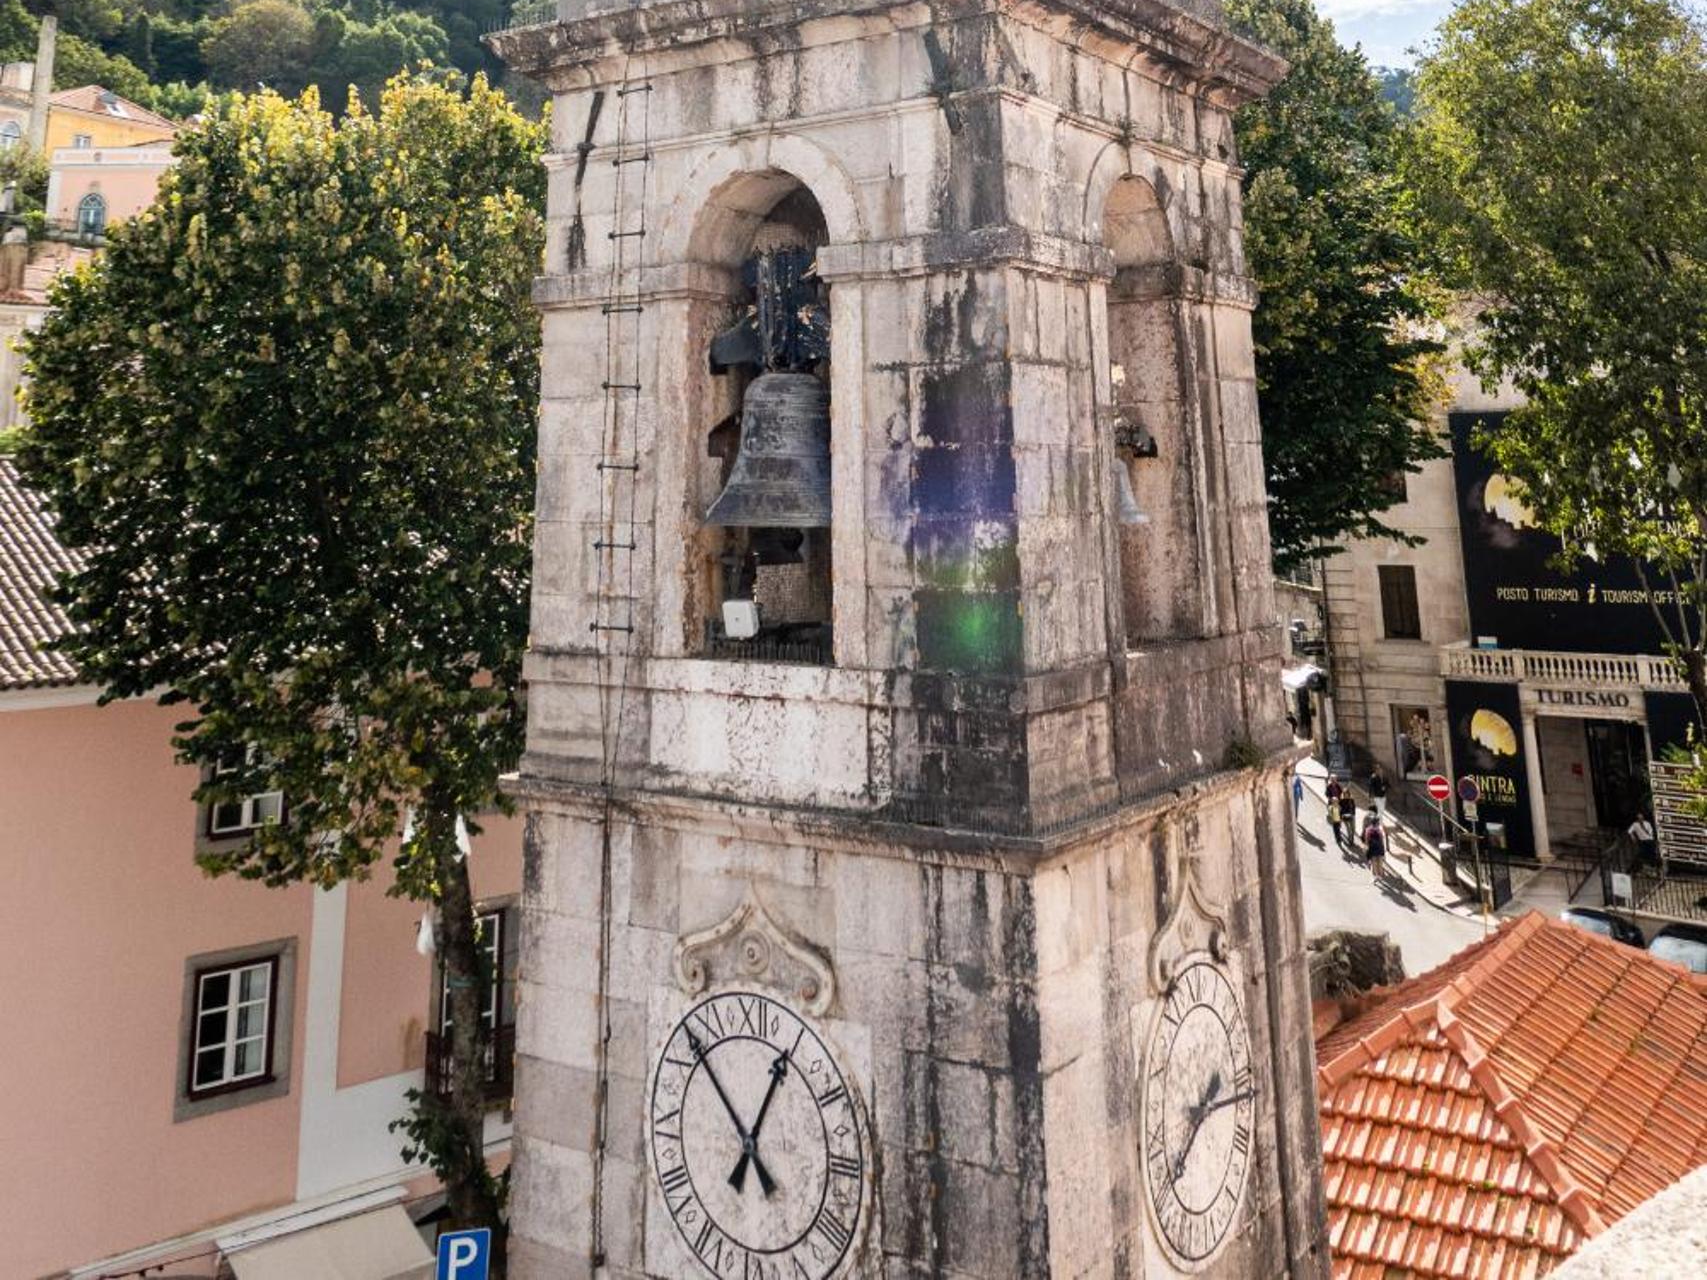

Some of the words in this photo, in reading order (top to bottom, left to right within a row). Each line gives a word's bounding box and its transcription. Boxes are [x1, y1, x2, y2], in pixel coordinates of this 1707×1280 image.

[1496, 587, 1529, 601] POSTO
[1533, 587, 1579, 602] TURISMO
[1601, 590, 1648, 604] TOURISM
[1534, 688, 1630, 707] TURISMO
[829, 1151, 860, 1180] III
[447, 1236, 478, 1280] P
